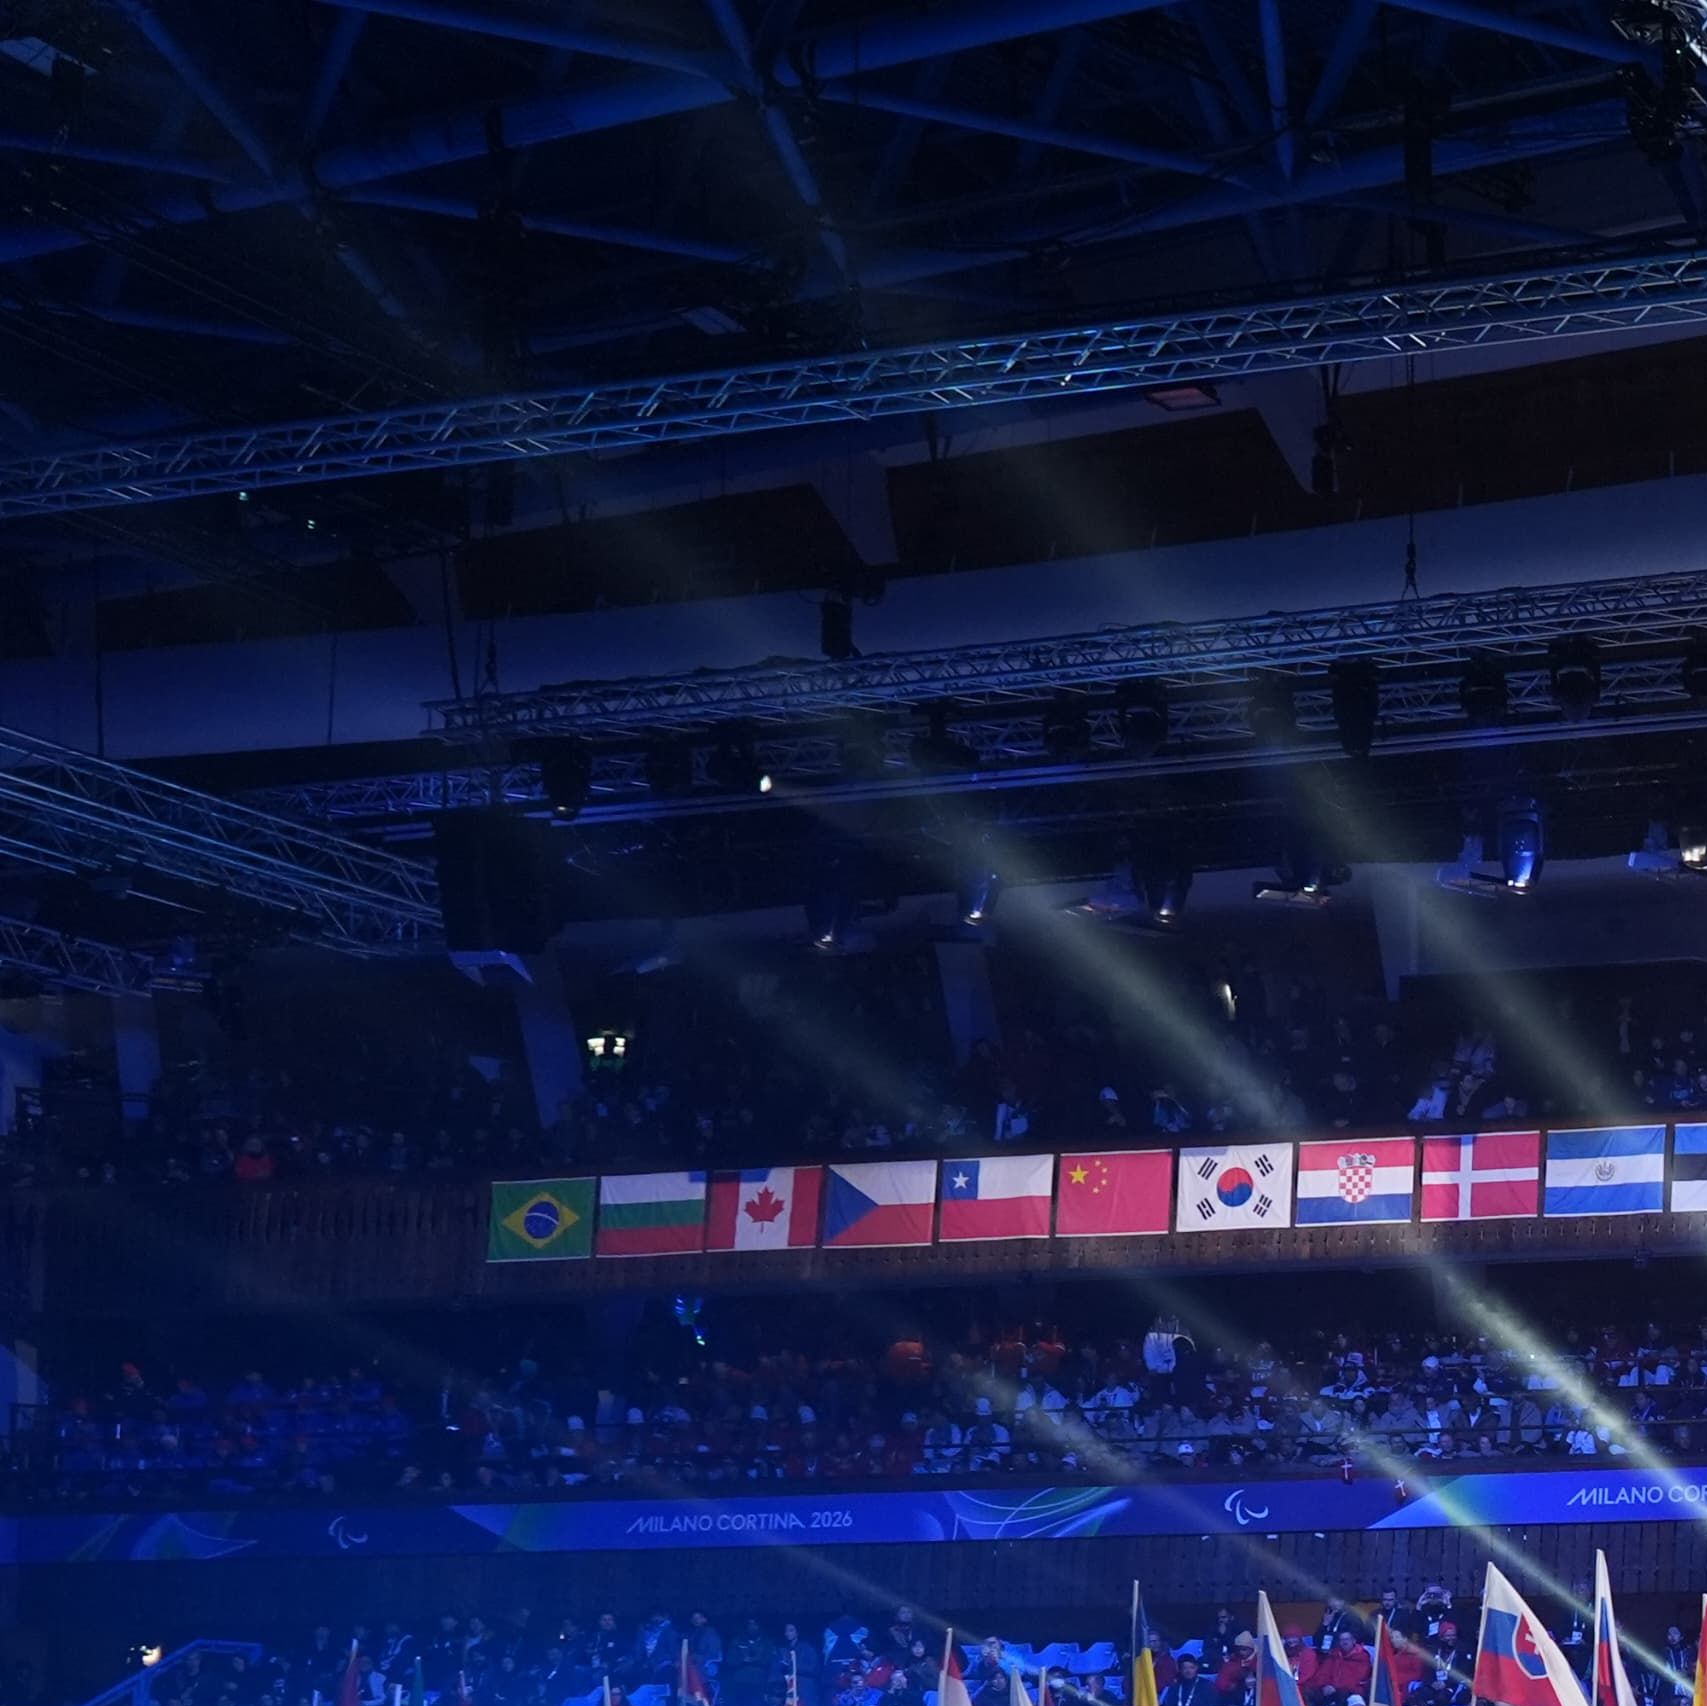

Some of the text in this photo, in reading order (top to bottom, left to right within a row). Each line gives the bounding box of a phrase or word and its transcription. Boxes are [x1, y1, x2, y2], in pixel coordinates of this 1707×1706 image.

[1567, 1486, 1663, 1506] MILANO
[626, 1510, 853, 1534] MILANO CORTINA 2026
